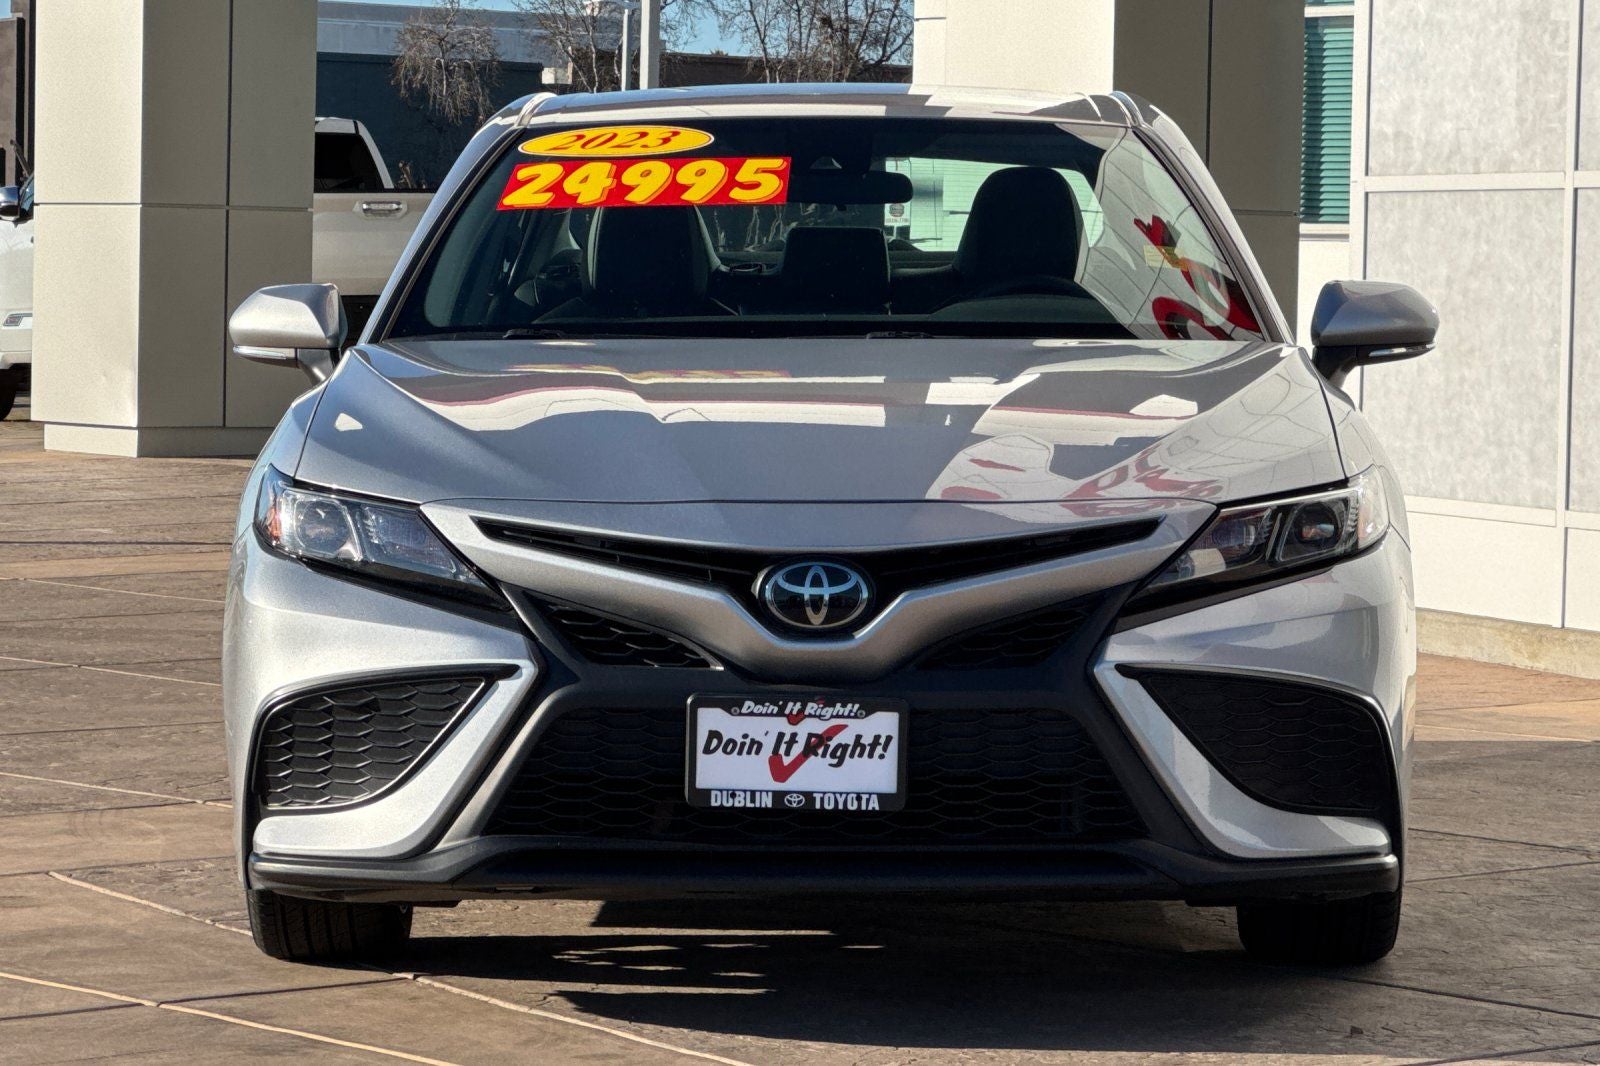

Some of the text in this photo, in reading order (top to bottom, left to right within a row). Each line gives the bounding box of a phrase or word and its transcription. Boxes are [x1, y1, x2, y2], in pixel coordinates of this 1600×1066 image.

[547, 131, 681, 151] 2023
[502, 158, 788, 207] 24995
[740, 701, 860, 720] Doin' It Right!
[702, 730, 893, 767] Doin' It Right!
[710, 790, 879, 810] DUBLIN TOYOTA
